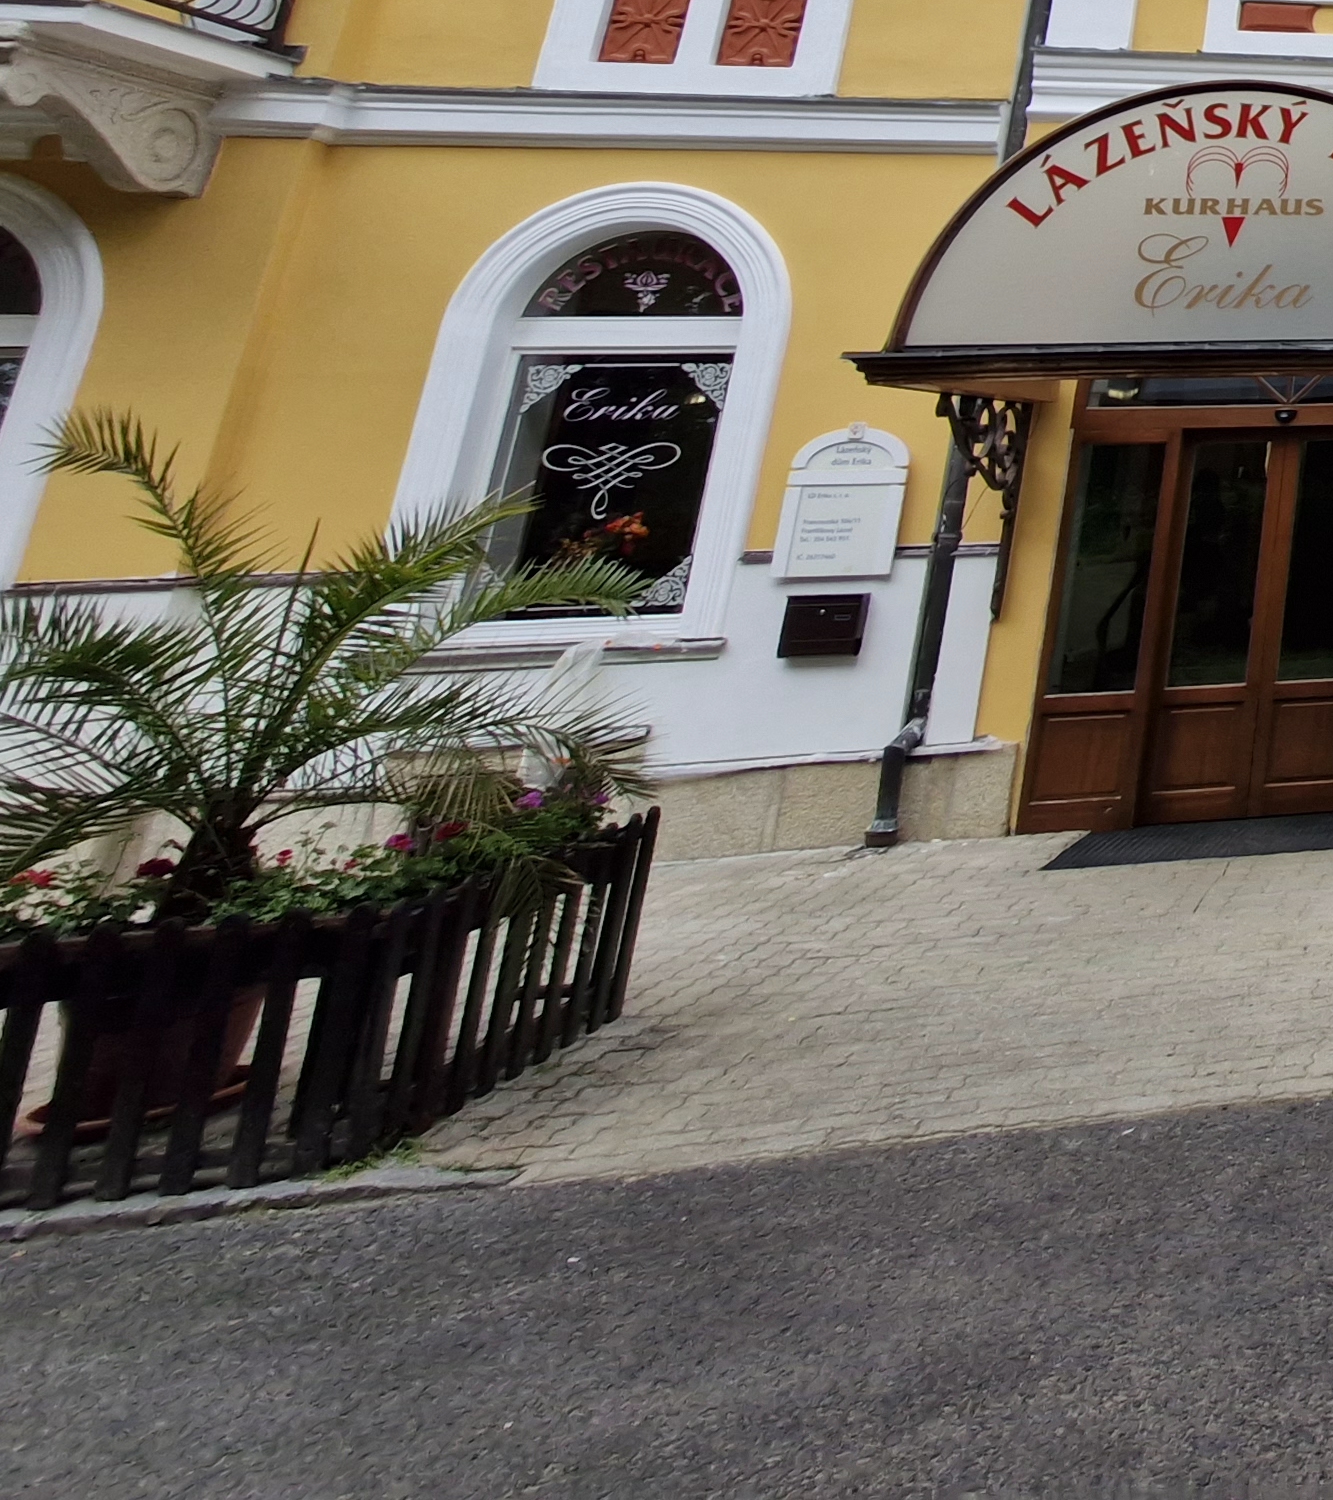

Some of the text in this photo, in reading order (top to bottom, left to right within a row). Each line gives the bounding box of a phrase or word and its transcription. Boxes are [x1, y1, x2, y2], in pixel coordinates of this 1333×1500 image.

[1005, 99, 1310, 229] LÁZEŇSKÝ
[1142, 197, 1325, 217] KURHAUS
[1133, 232, 1315, 318] Erika
[563, 387, 681, 422] Erika
